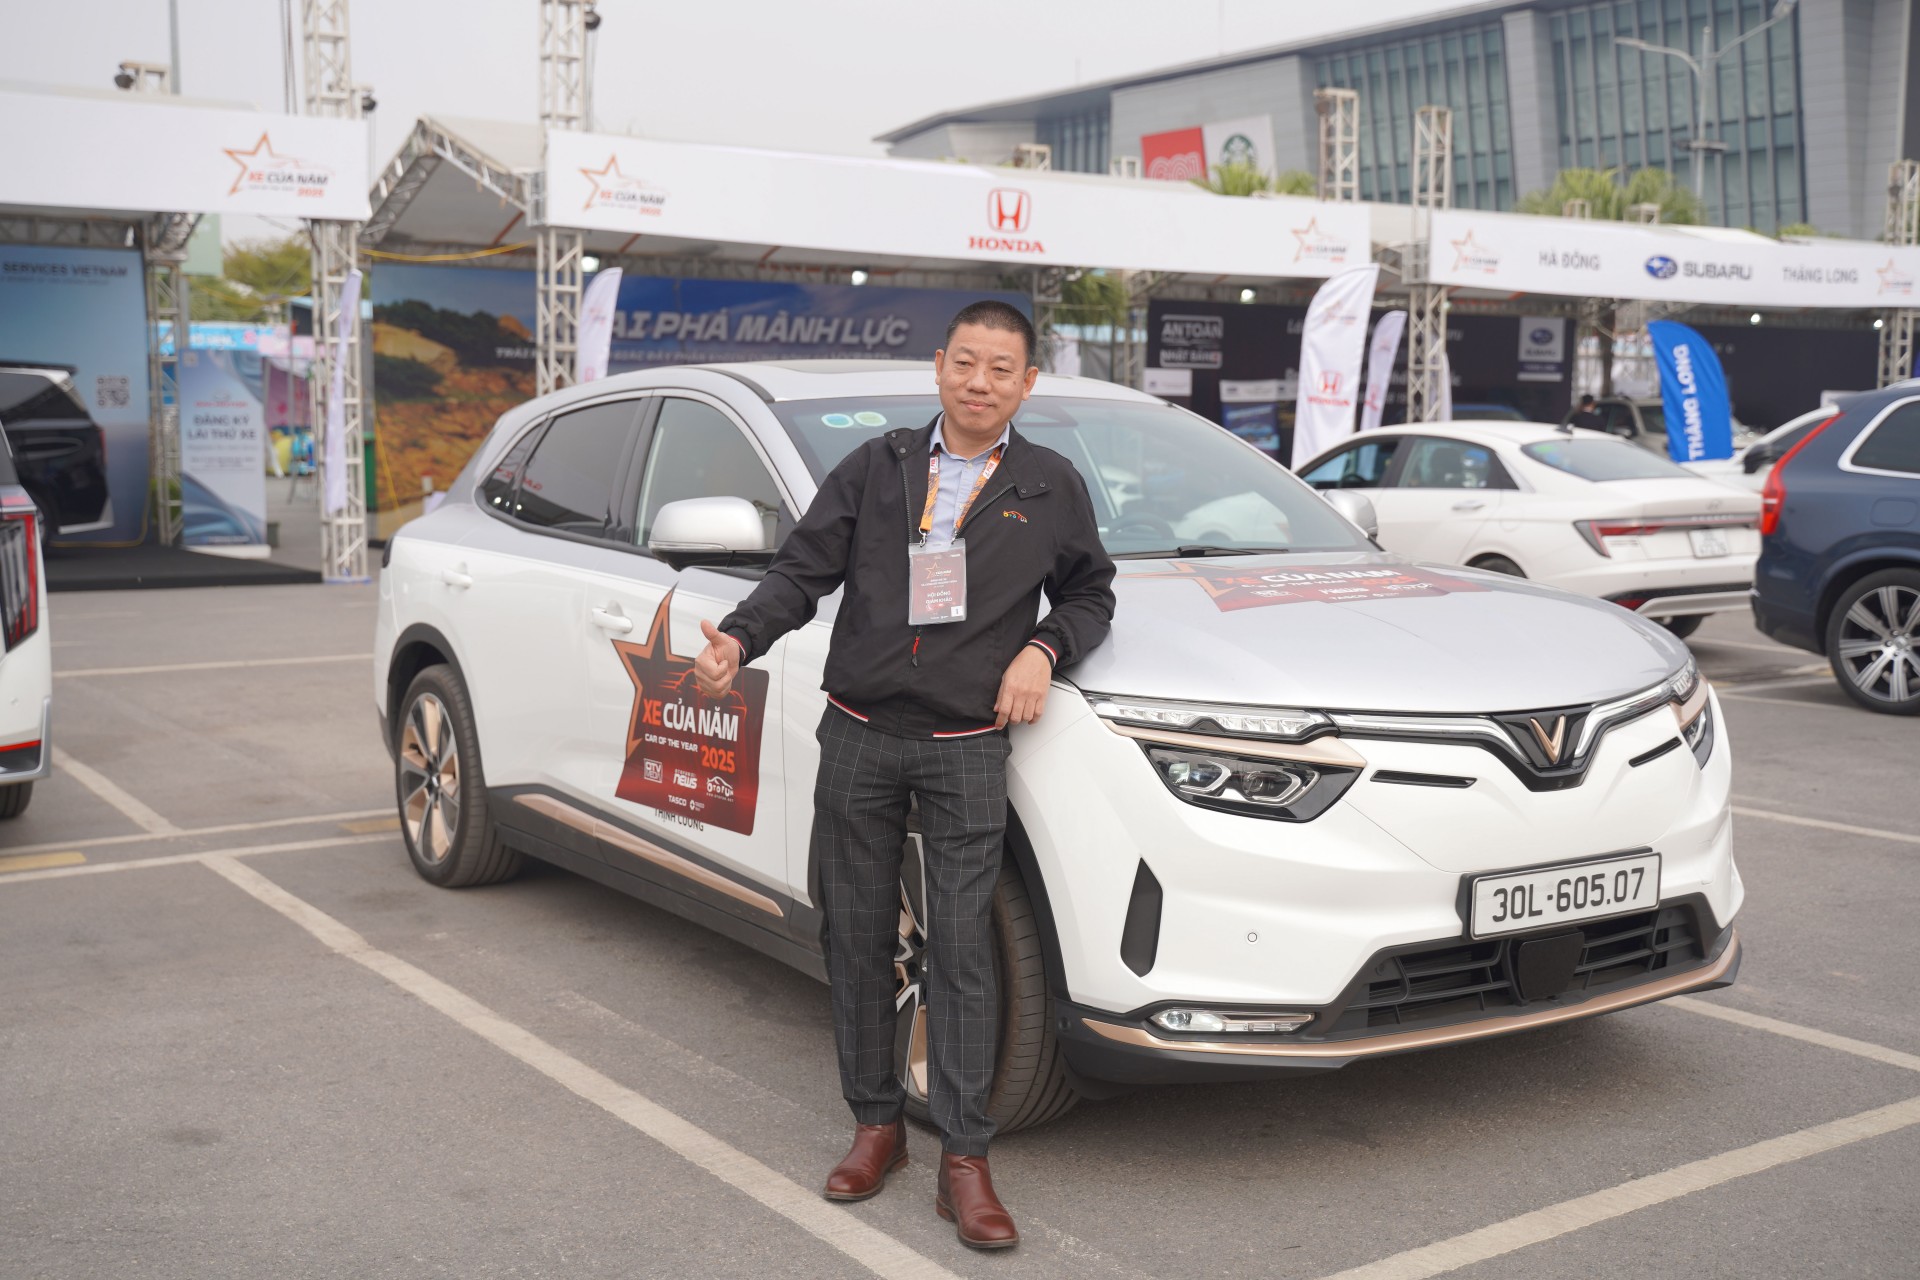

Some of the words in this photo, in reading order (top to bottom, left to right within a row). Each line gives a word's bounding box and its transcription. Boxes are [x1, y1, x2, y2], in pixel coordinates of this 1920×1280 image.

[968, 235, 1046, 254] HONDA
[3, 262, 69, 275] SERVICES
[72, 264, 128, 277] VIETNAM
[1683, 261, 1753, 281] SUBARU
[1825, 267, 1859, 284] LONG
[652, 307, 729, 342] PHÁ
[841, 313, 909, 351] LỰC
[1673, 344, 1697, 394] LONG
[240, 428, 257, 440] XE
[1261, 572, 1332, 582] CỦA
[642, 698, 662, 727] XE
[663, 698, 696, 734] CỦA
[698, 706, 739, 742] NĂM
[644, 733, 658, 745] CAR
[658, 735, 667, 745] OF
[667, 738, 680, 748] THE
[680, 740, 698, 753] YEAR
[701, 745, 735, 774] 2025
[706, 782, 734, 797] OTOFUN
[668, 794, 687, 807] TASCO
[1492, 866, 1645, 923] 30L-605.07
